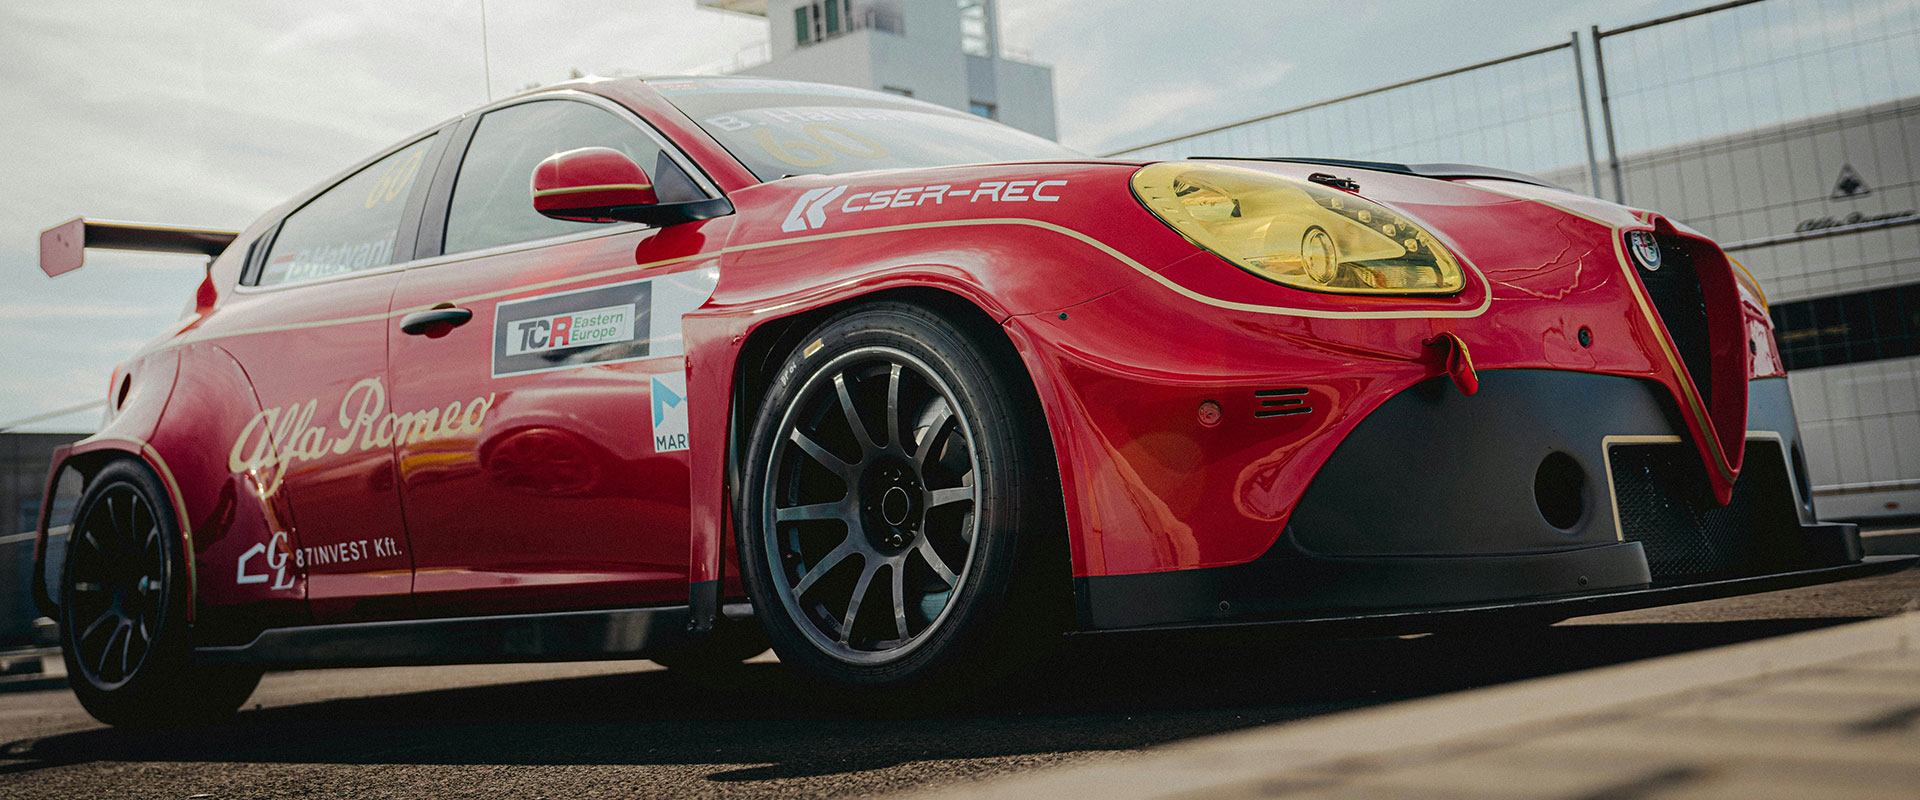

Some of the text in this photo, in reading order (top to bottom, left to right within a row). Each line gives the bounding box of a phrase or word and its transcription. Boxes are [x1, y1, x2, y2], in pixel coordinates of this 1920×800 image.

[753, 124, 889, 168] 60
[365, 149, 425, 210] 60
[841, 180, 1068, 213] CSER-REC
[518, 315, 572, 352] TCR
[571, 325, 617, 342] Europe
[573, 311, 624, 329] Eastern
[229, 376, 496, 499] Alfa Romeo
[656, 433, 690, 451] MAR
[295, 537, 403, 568] 87INVEST Kft.
